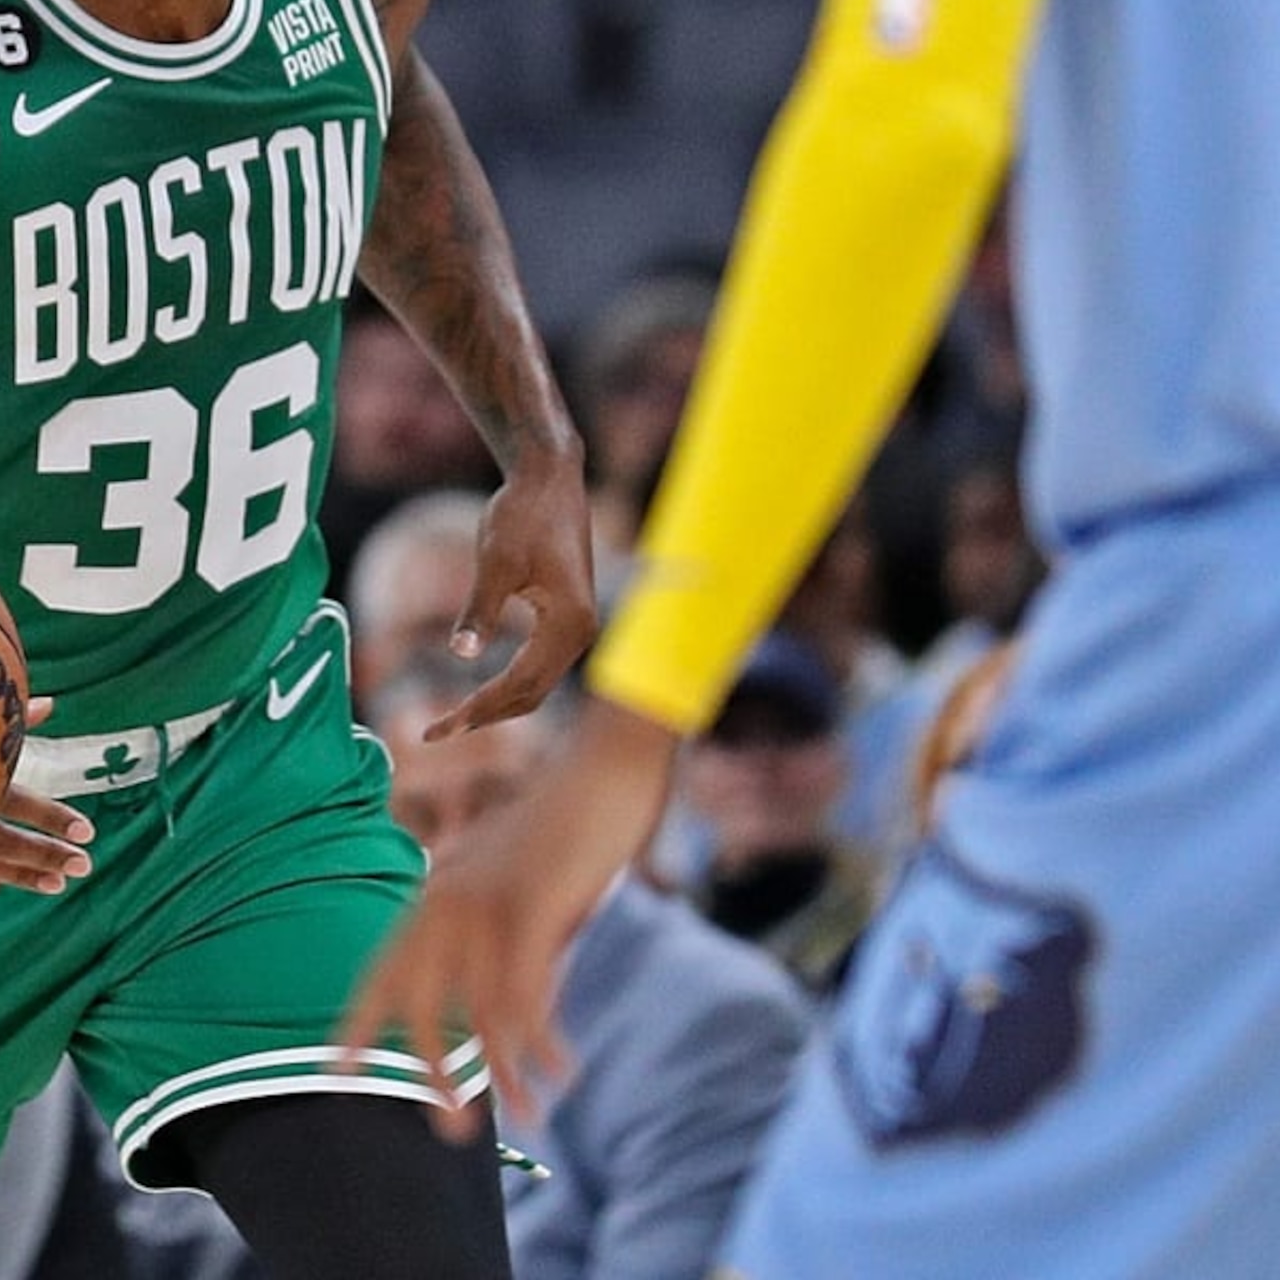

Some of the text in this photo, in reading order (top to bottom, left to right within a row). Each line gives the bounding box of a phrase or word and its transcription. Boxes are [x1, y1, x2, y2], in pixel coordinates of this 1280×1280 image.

[282, 31, 345, 89] PRINT
[14, 119, 365, 385] BOSTON
[20, 341, 319, 615] 36
